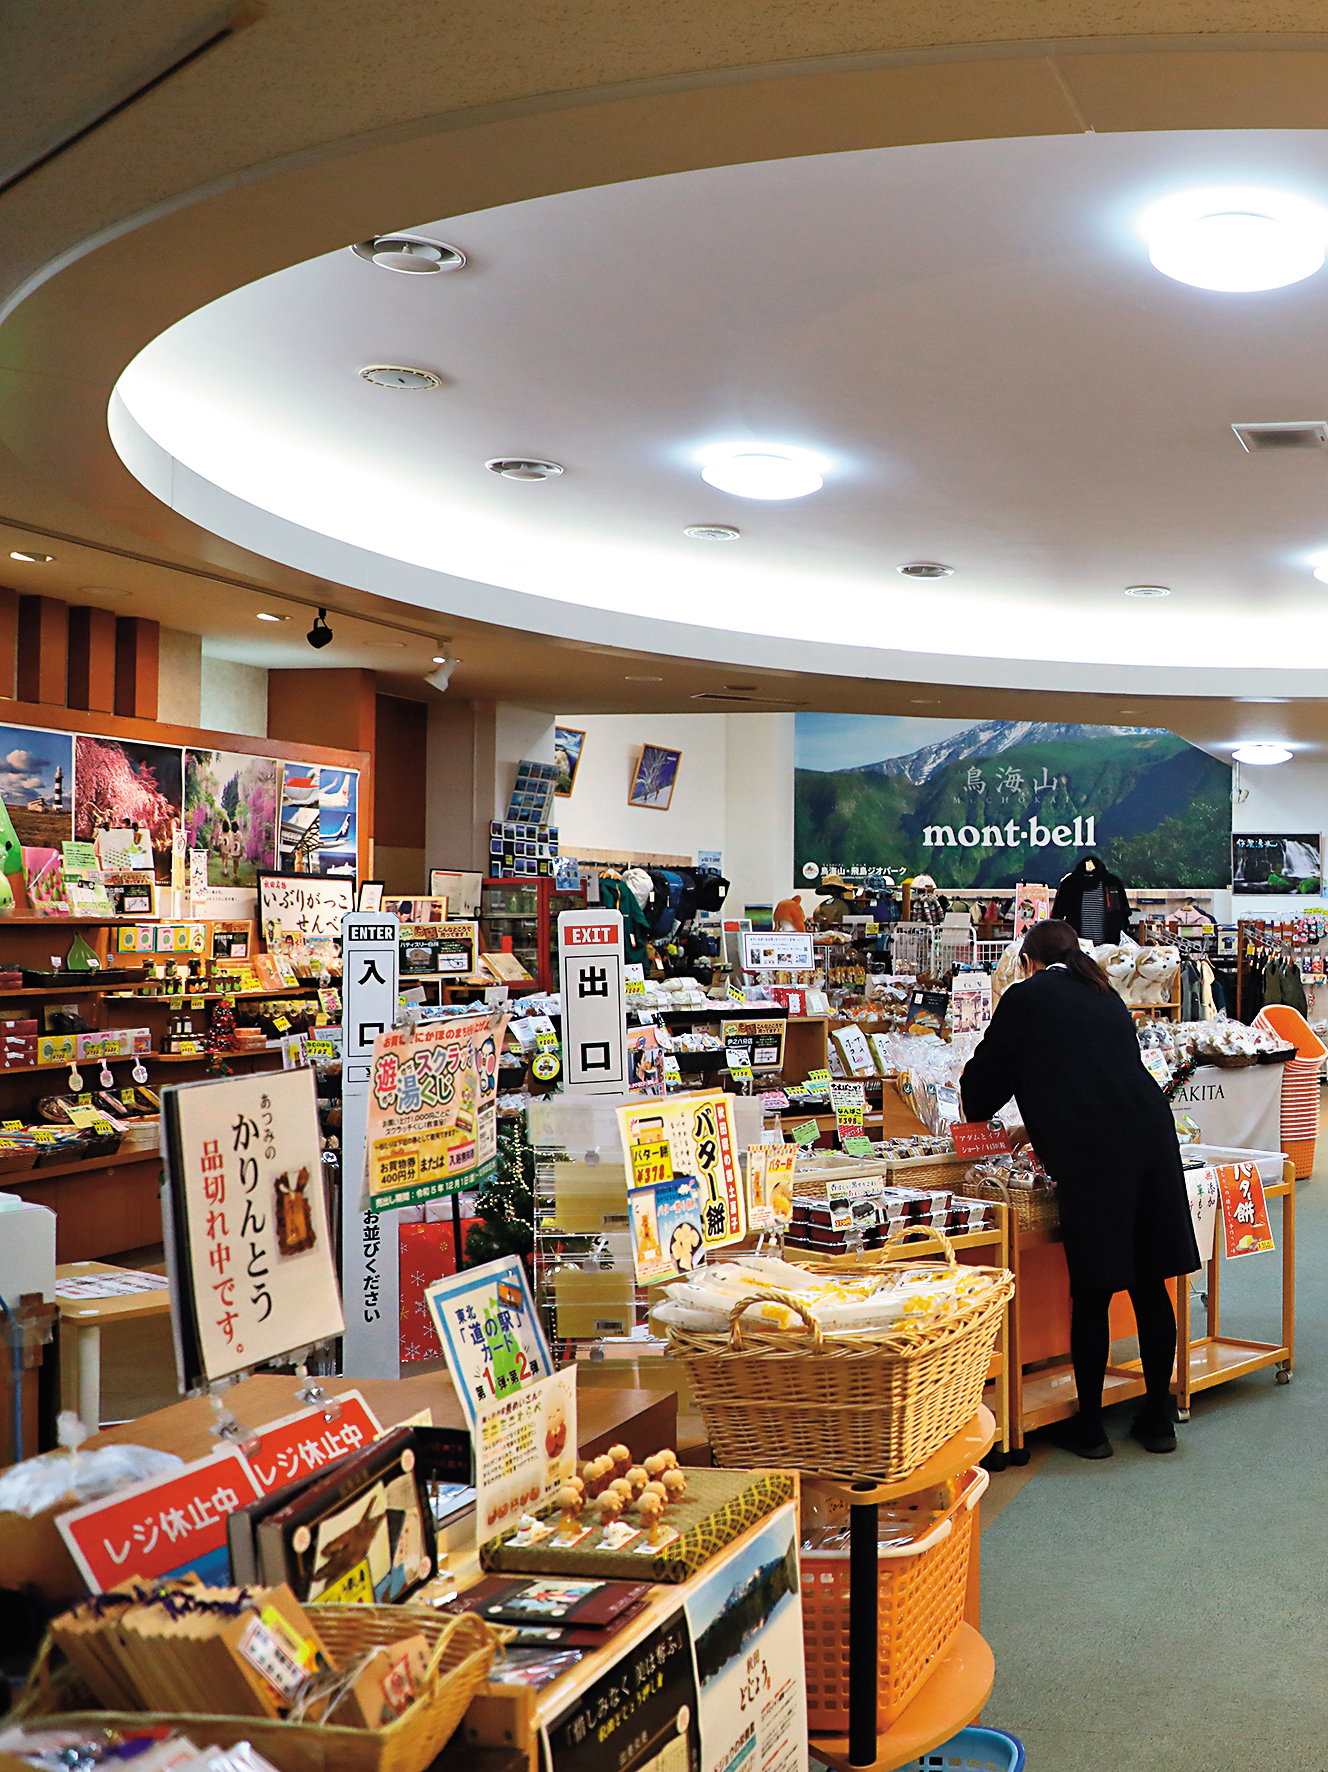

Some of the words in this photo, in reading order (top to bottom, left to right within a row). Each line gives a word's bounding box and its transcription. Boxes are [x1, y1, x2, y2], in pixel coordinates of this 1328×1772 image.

[963, 765, 1058, 795] 鳥海山
[263, 889, 349, 912] いぶりがっこ
[296, 914, 341, 934] せんべ
[351, 927, 393, 940] ENTER
[572, 928, 612, 942] EXIT
[358, 960, 386, 1047] 入口
[579, 966, 611, 1072] 出口
[377, 1057, 397, 1093] 遊
[420, 1076, 453, 1103] くじ
[397, 1075, 420, 1110] 湯
[1178, 1084, 1225, 1102] AKITA
[837, 1107, 862, 1115] なんばこ
[260, 1093, 276, 1160] あつみの
[420, 1156, 445, 1173] または
[633, 1144, 669, 1162] バター餅
[381, 1170, 416, 1184] 400円分
[637, 1164, 665, 1184] ¥378
[694, 1106, 726, 1237] バター餅
[231, 1113, 273, 1323] かりんとう
[200, 1138, 245, 1355] 品切れ中です。
[363, 1210, 381, 1324] お並びください
[455, 1304, 477, 1324] 東北
[460, 1309, 523, 1346] 「道の駅」
[480, 1333, 514, 1363] カード
[253, 1423, 364, 1486] レジ休止中
[103, 1486, 240, 1565] レジ休止中
